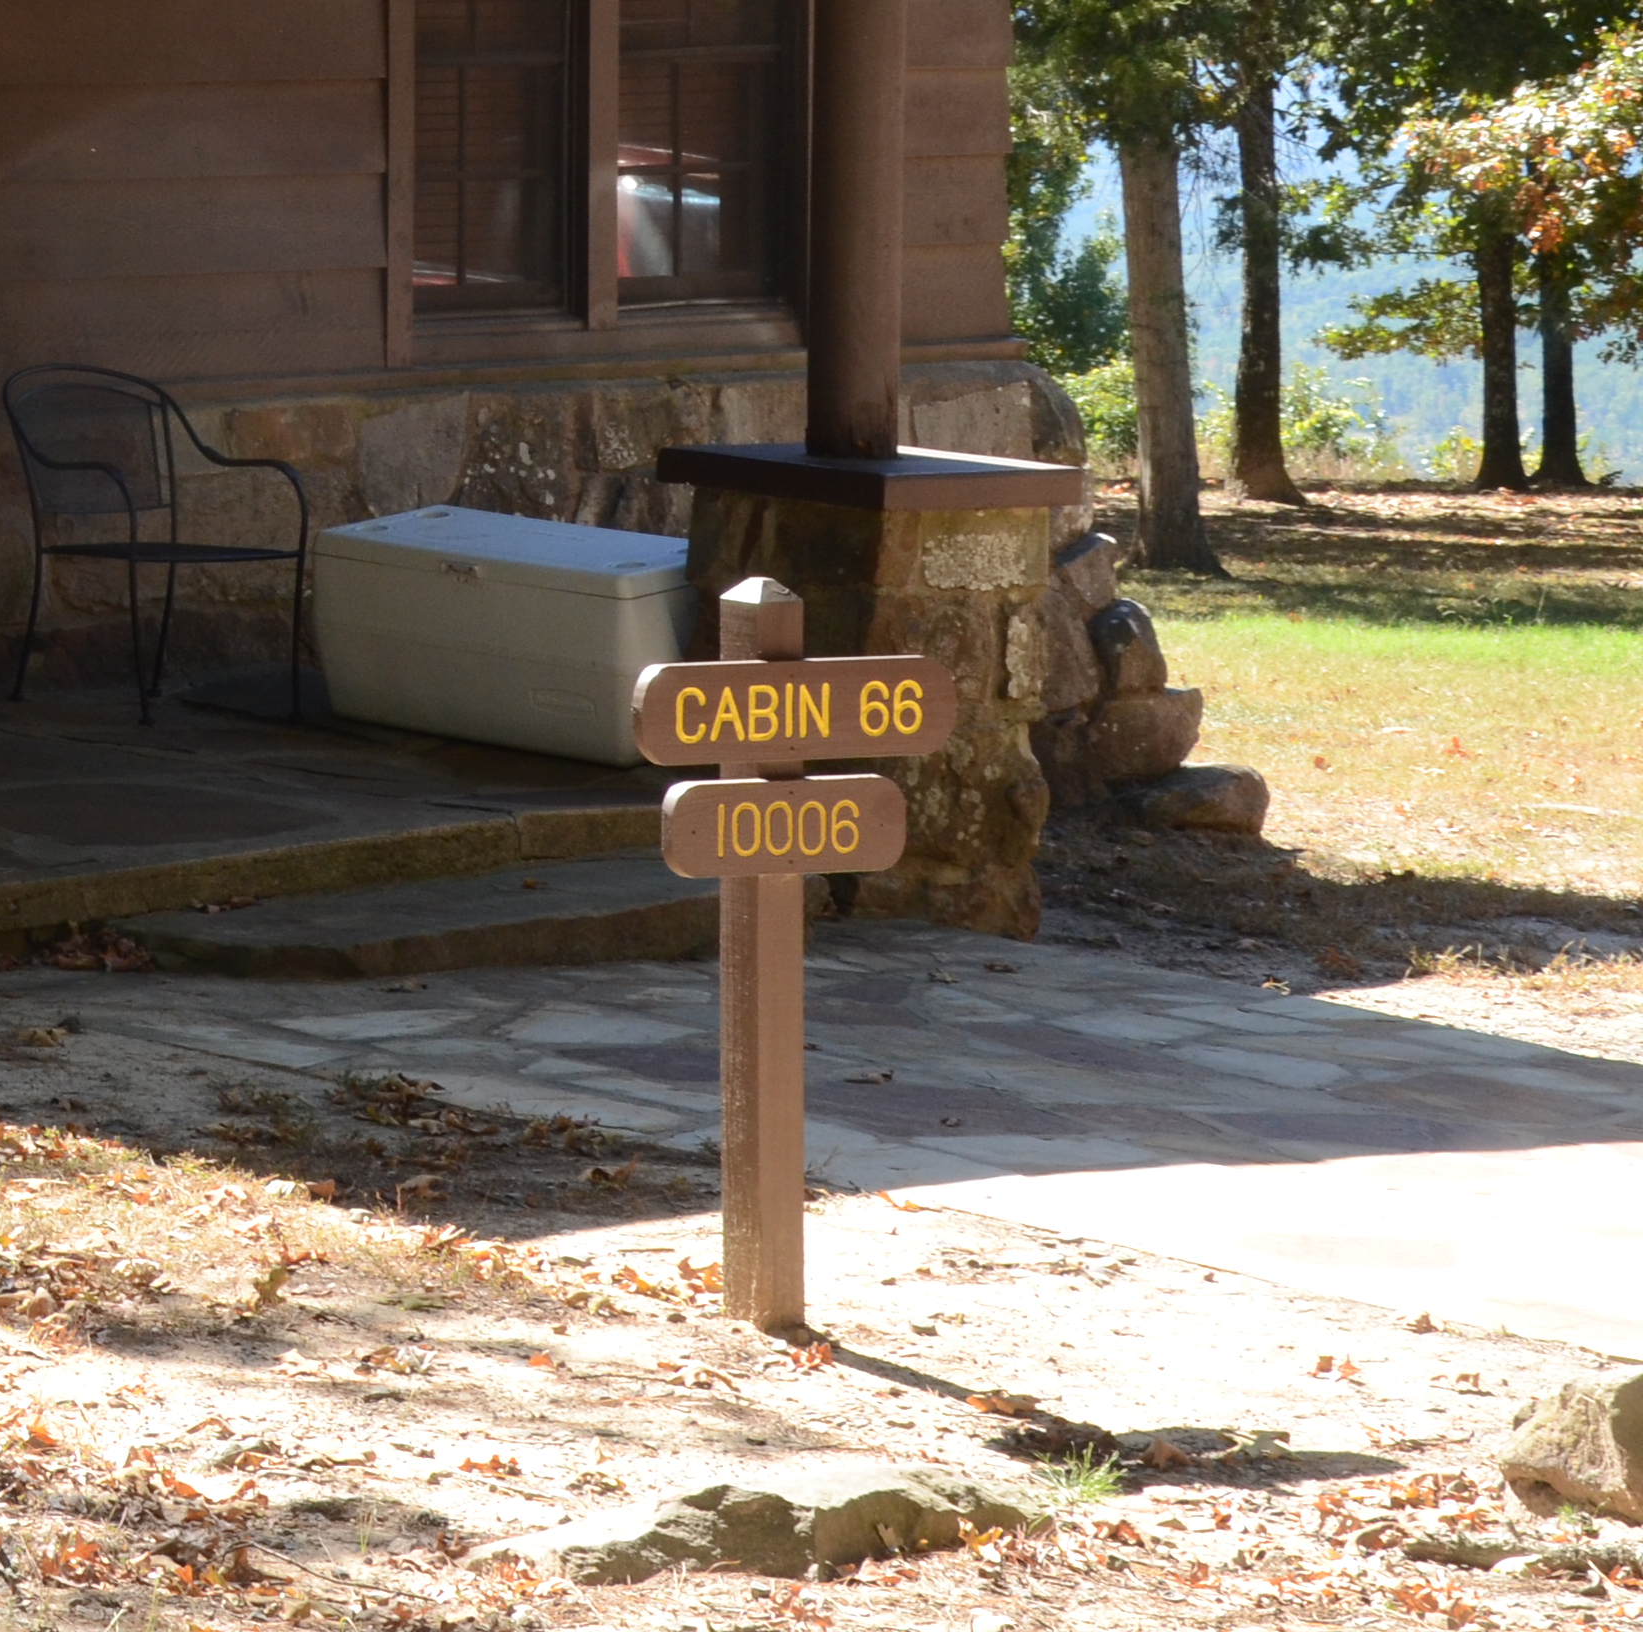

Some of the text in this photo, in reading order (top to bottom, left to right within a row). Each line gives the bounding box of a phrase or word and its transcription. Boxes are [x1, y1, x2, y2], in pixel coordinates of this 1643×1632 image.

[675, 679, 924, 745] CABIN 66
[717, 799, 860, 858] 10006
